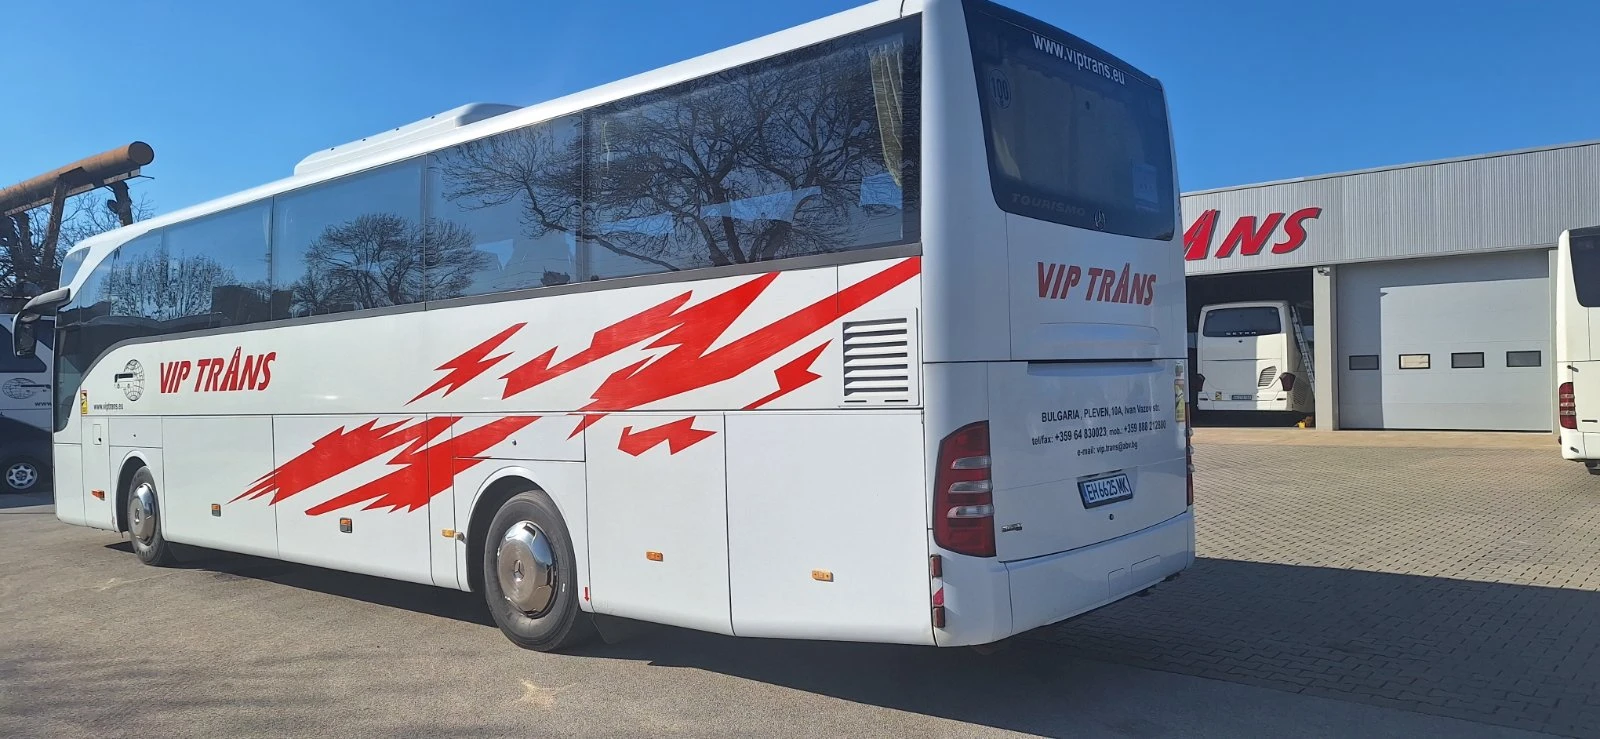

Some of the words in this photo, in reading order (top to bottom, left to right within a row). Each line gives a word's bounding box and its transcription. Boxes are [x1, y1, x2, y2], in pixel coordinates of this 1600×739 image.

[1032, 33, 1125, 85] www.viptrans.eu
[1012, 193, 1086, 217] TOURISMO
[1037, 262, 1082, 300] VIP
[1085, 262, 1157, 306] TRANS
[159, 360, 191, 394] VIP
[194, 346, 277, 393] TRANS
[1054, 430, 1072, 442] +359
[1073, 428, 1082, 440] 64
[1124, 422, 1138, 433] +359
